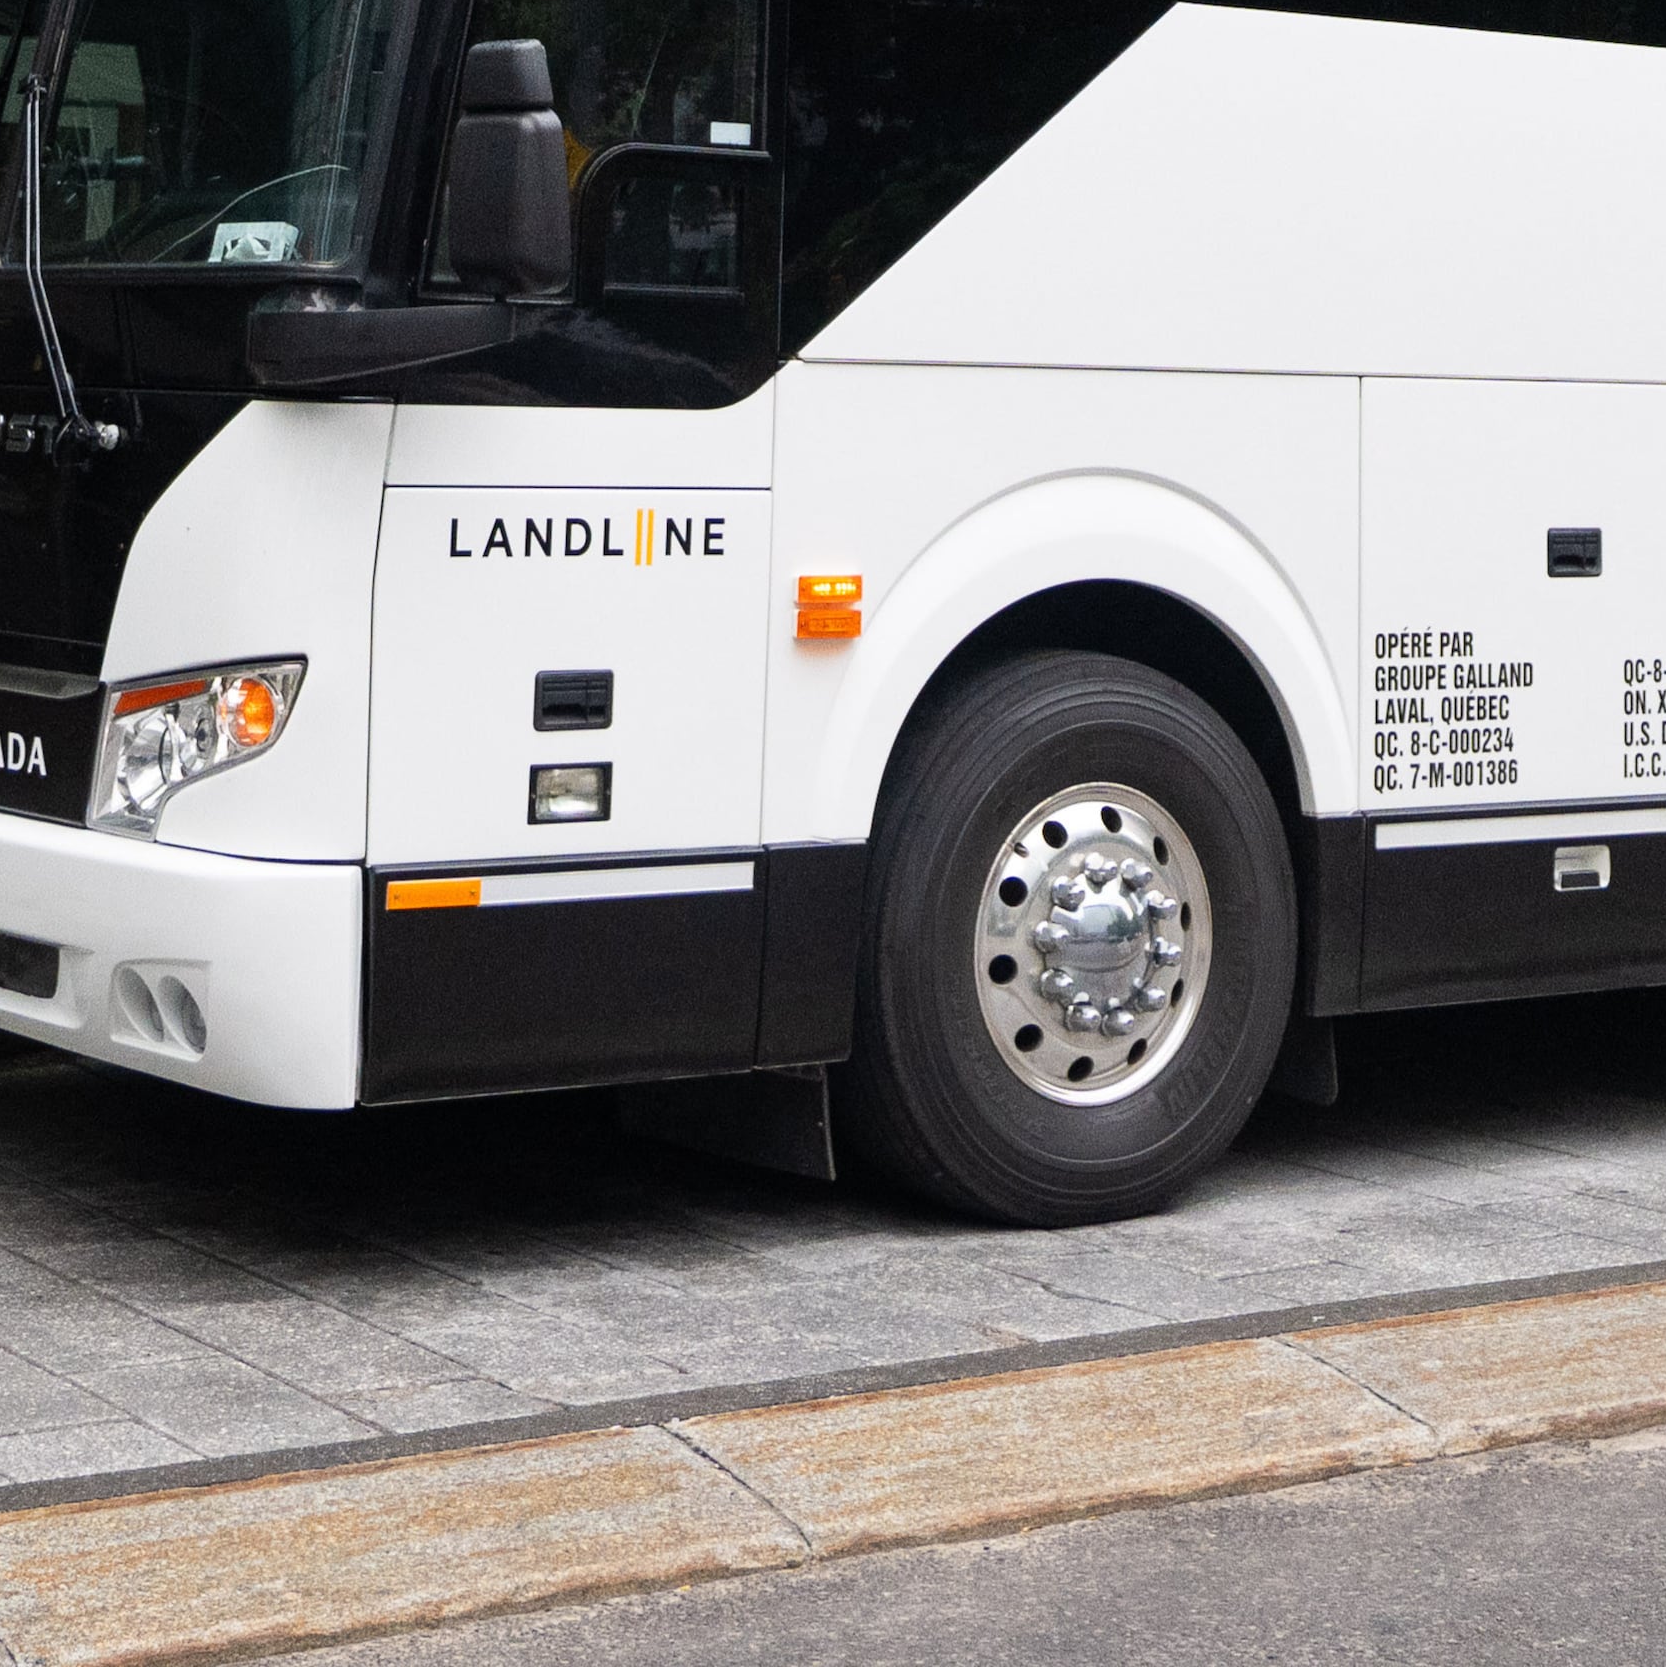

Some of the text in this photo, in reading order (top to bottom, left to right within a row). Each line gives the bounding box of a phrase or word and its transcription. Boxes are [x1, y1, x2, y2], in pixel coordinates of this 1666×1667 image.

[1375, 626, 1473, 659] OPÉRÉ PAR
[1375, 662, 1533, 692] GROUPE GALLAND
[1375, 689, 1510, 725] LAVAL, QUÉBEC
[1623, 690, 1652, 715] ON.
[1374, 727, 1514, 761] QC. 8-C-000234
[1623, 721, 1655, 747] U.S.
[1374, 759, 1518, 794] QC. 7-M-001386
[1623, 752, 1666, 779] I.C.C.
